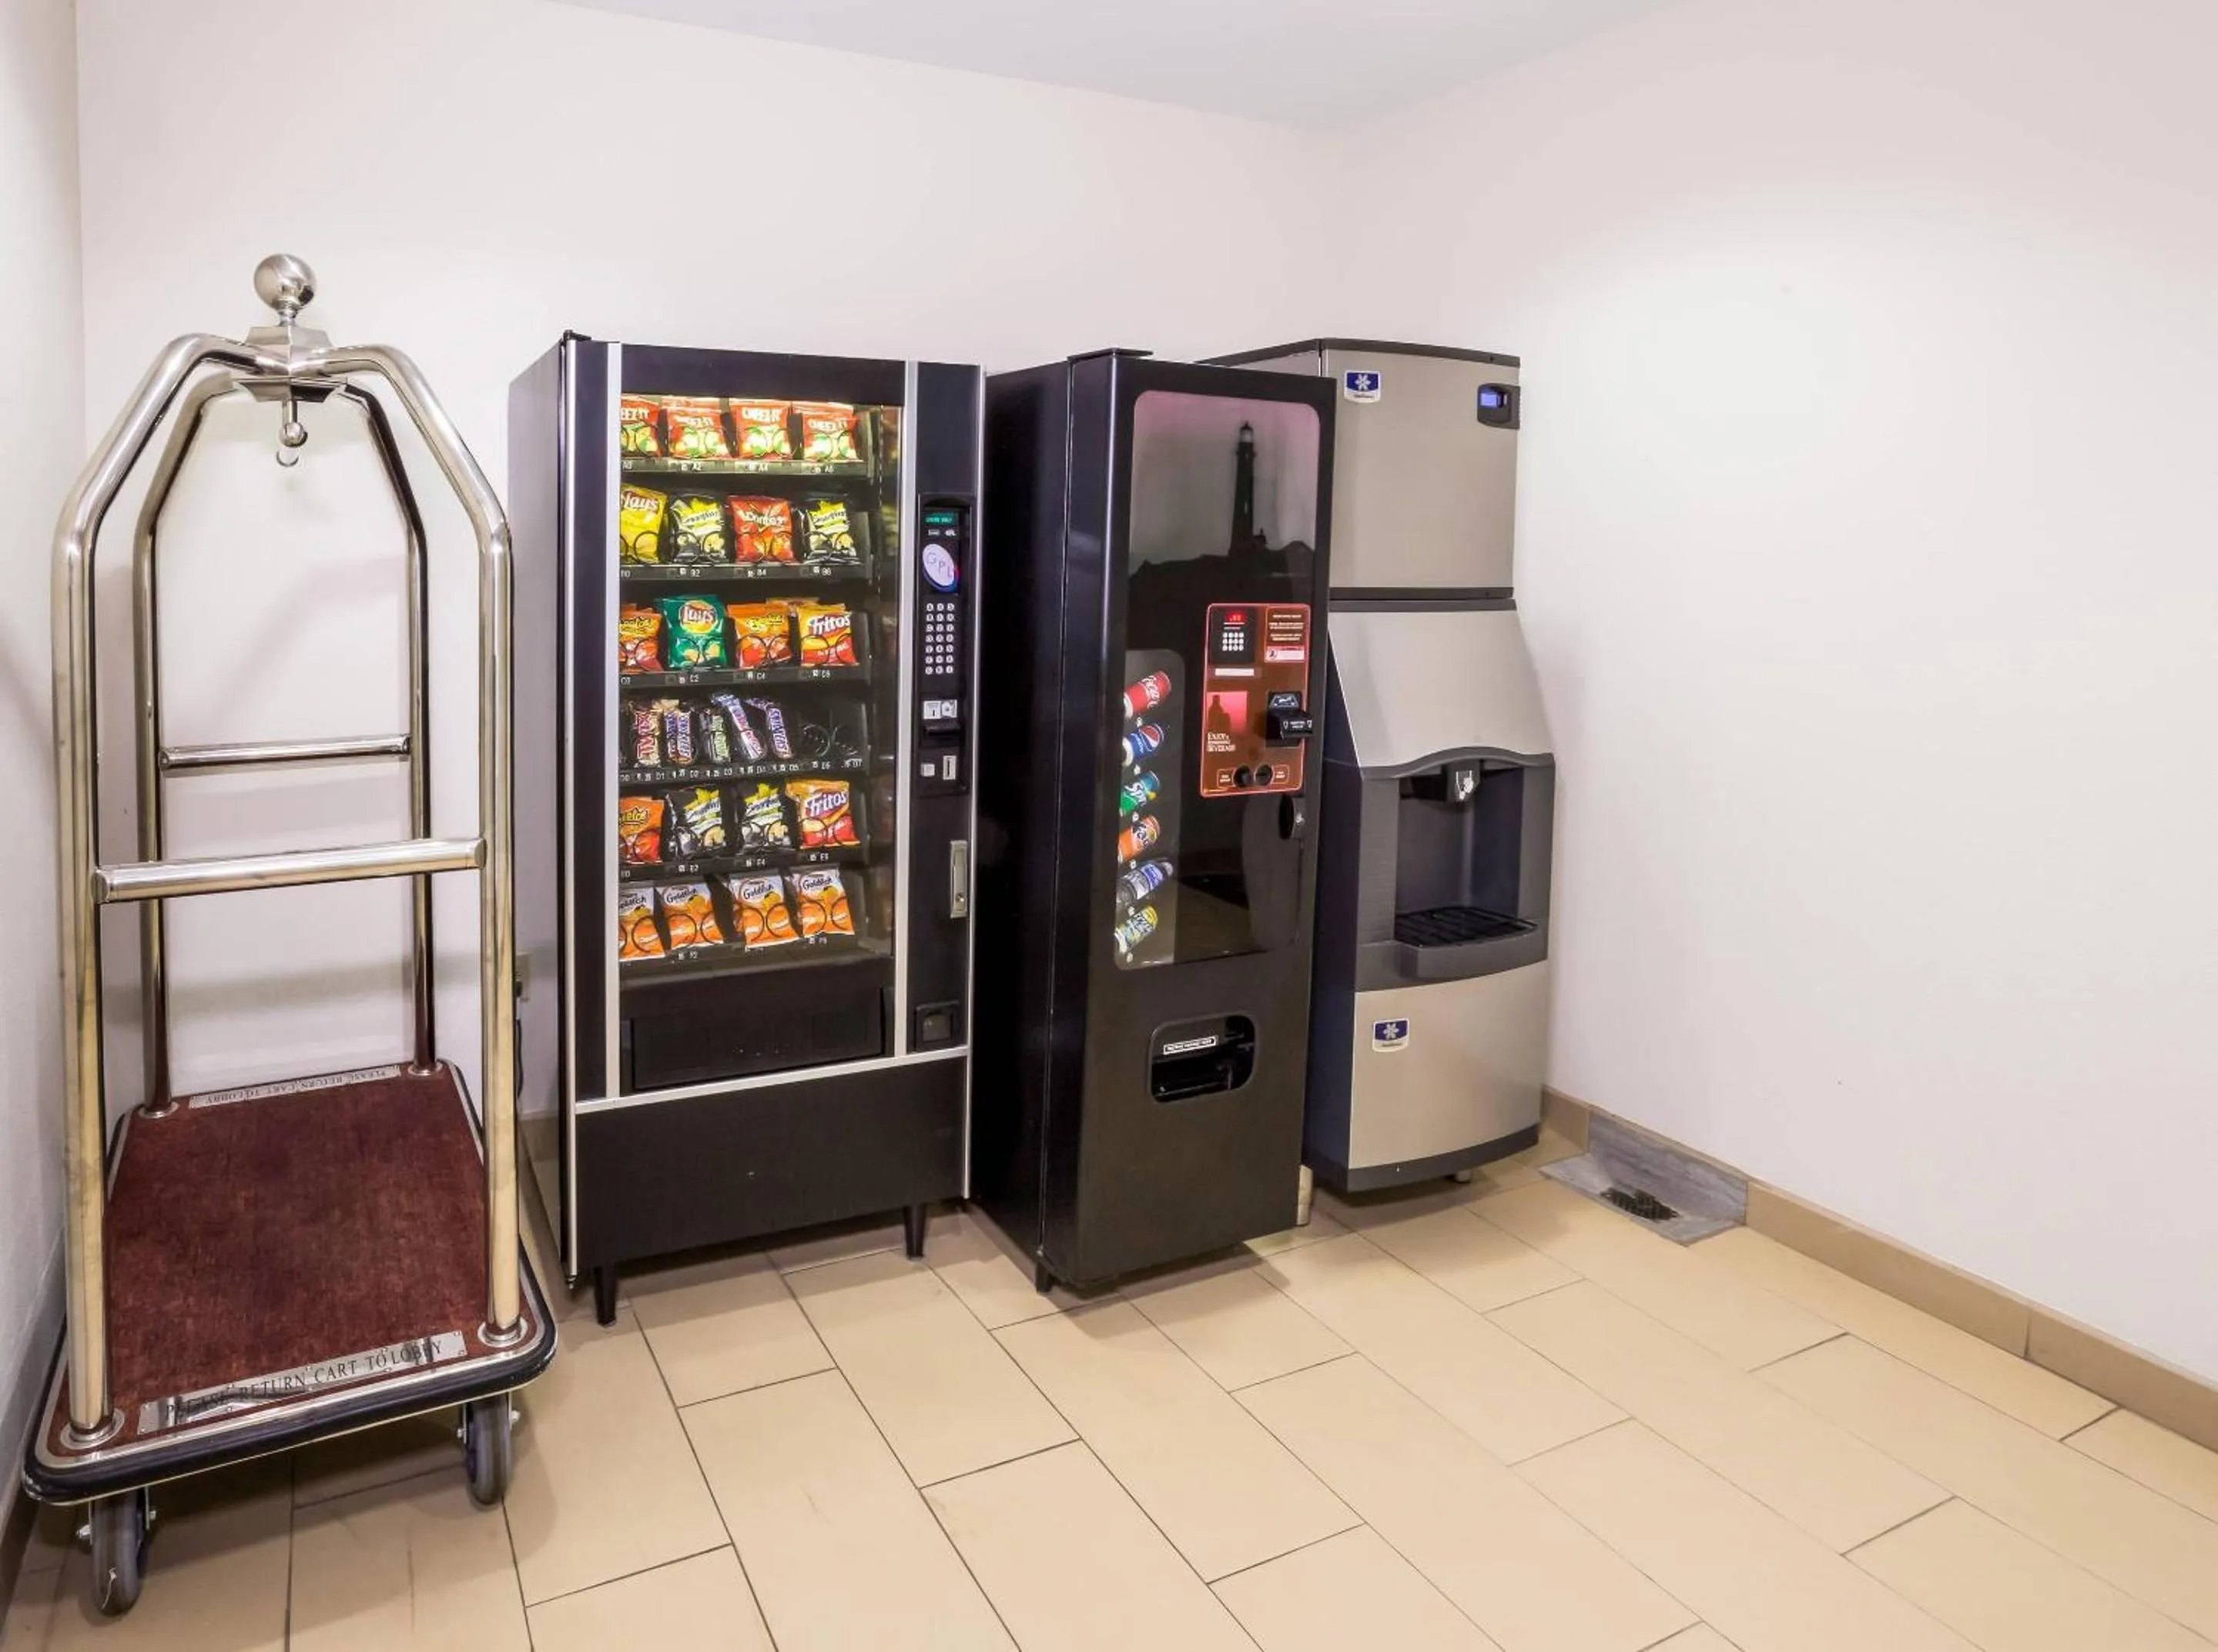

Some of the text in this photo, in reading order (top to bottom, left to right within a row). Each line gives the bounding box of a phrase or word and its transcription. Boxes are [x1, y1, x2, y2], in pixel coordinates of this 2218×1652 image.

[806, 612, 852, 635] Fritos
[806, 790, 848, 817] Fritos
[240, 1372, 307, 1399] RETURN
[314, 1359, 357, 1384] CART
[365, 1350, 387, 1371] TO
